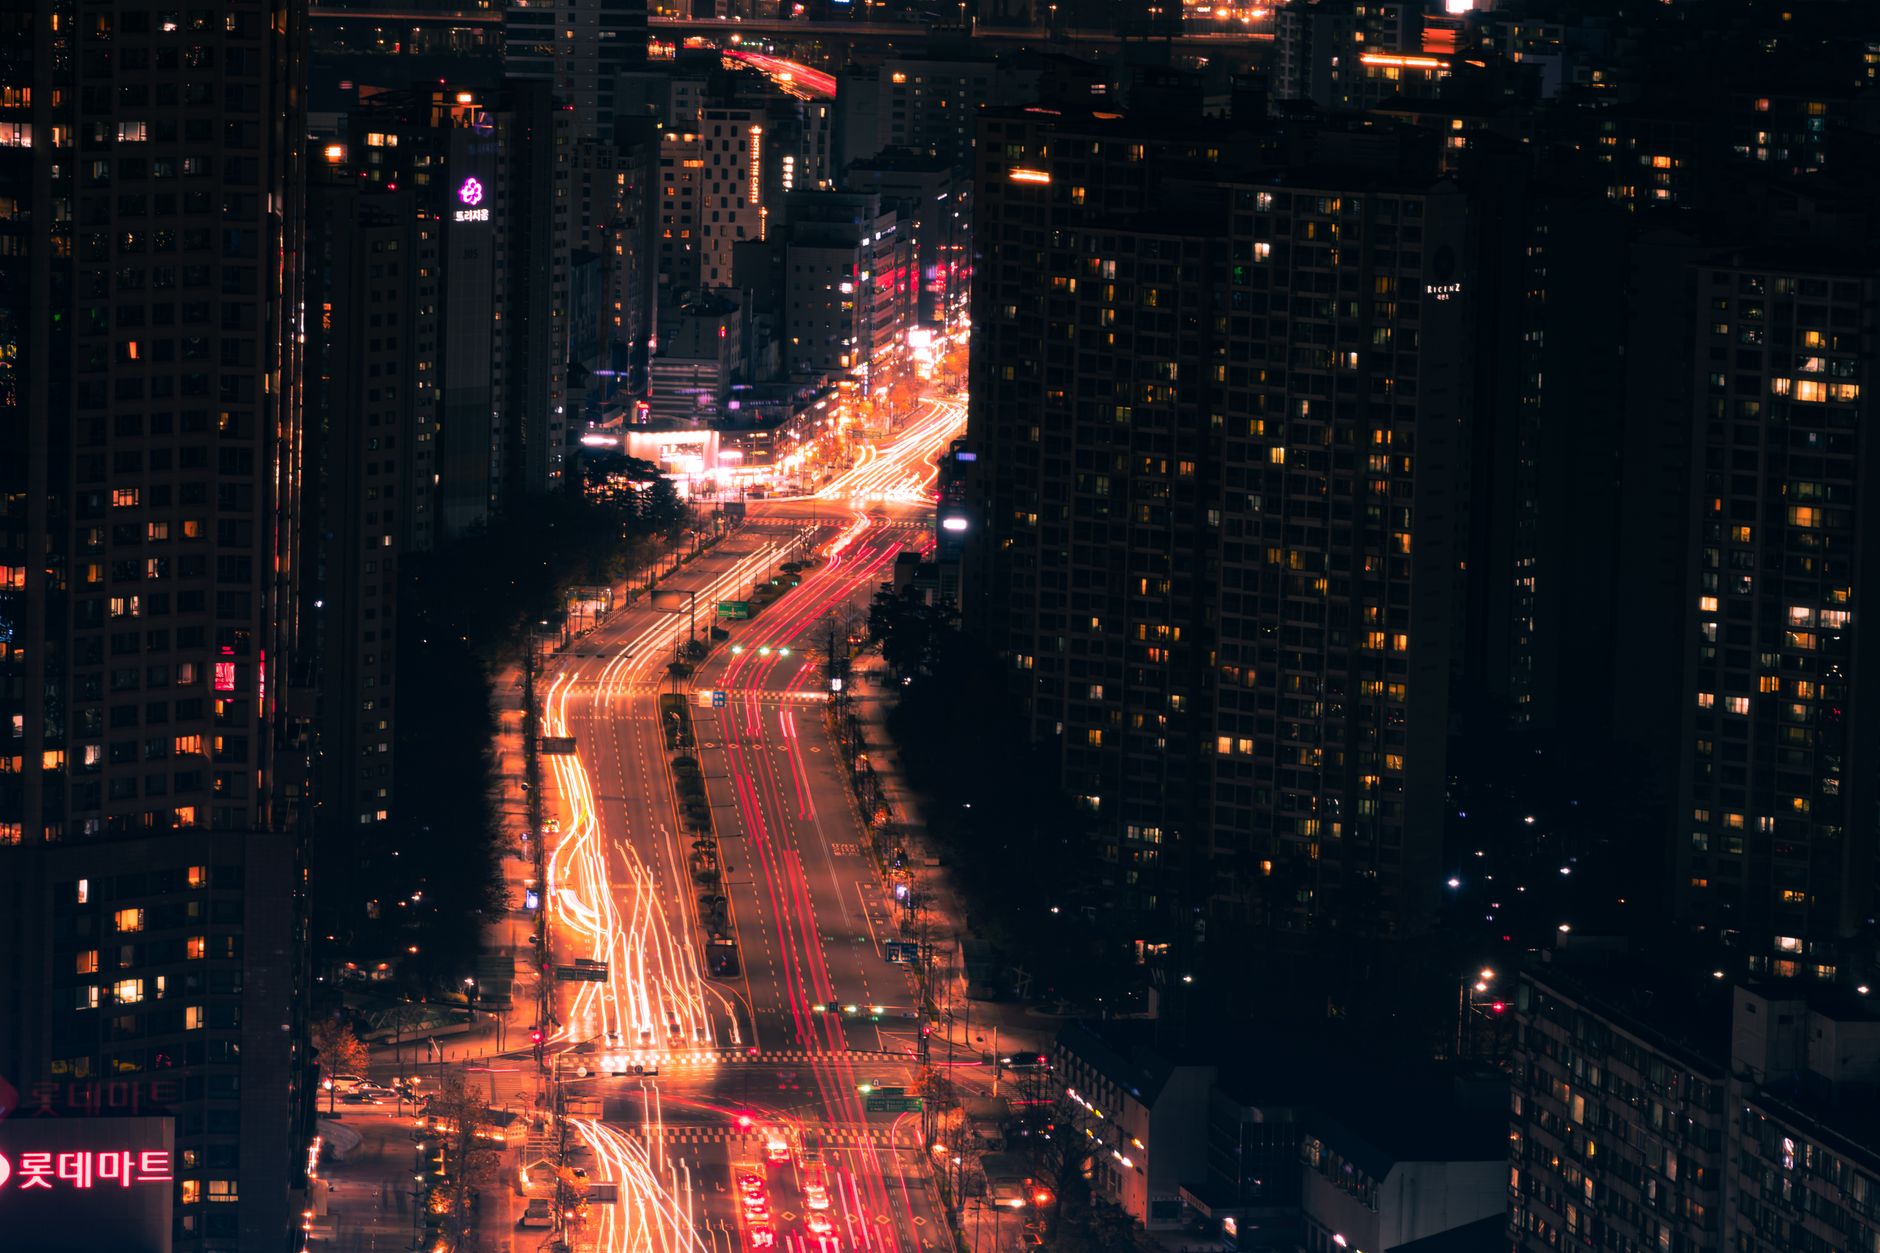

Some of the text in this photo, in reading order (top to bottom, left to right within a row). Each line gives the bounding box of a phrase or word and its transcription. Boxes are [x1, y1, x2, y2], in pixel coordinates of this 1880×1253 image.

[750, 135, 760, 204] HOTEL THE CASTLE
[455, 208, 488, 221] 트리지움
[31, 1080, 178, 1116] 롯데마트
[18, 1151, 174, 1189] 롯데마트
